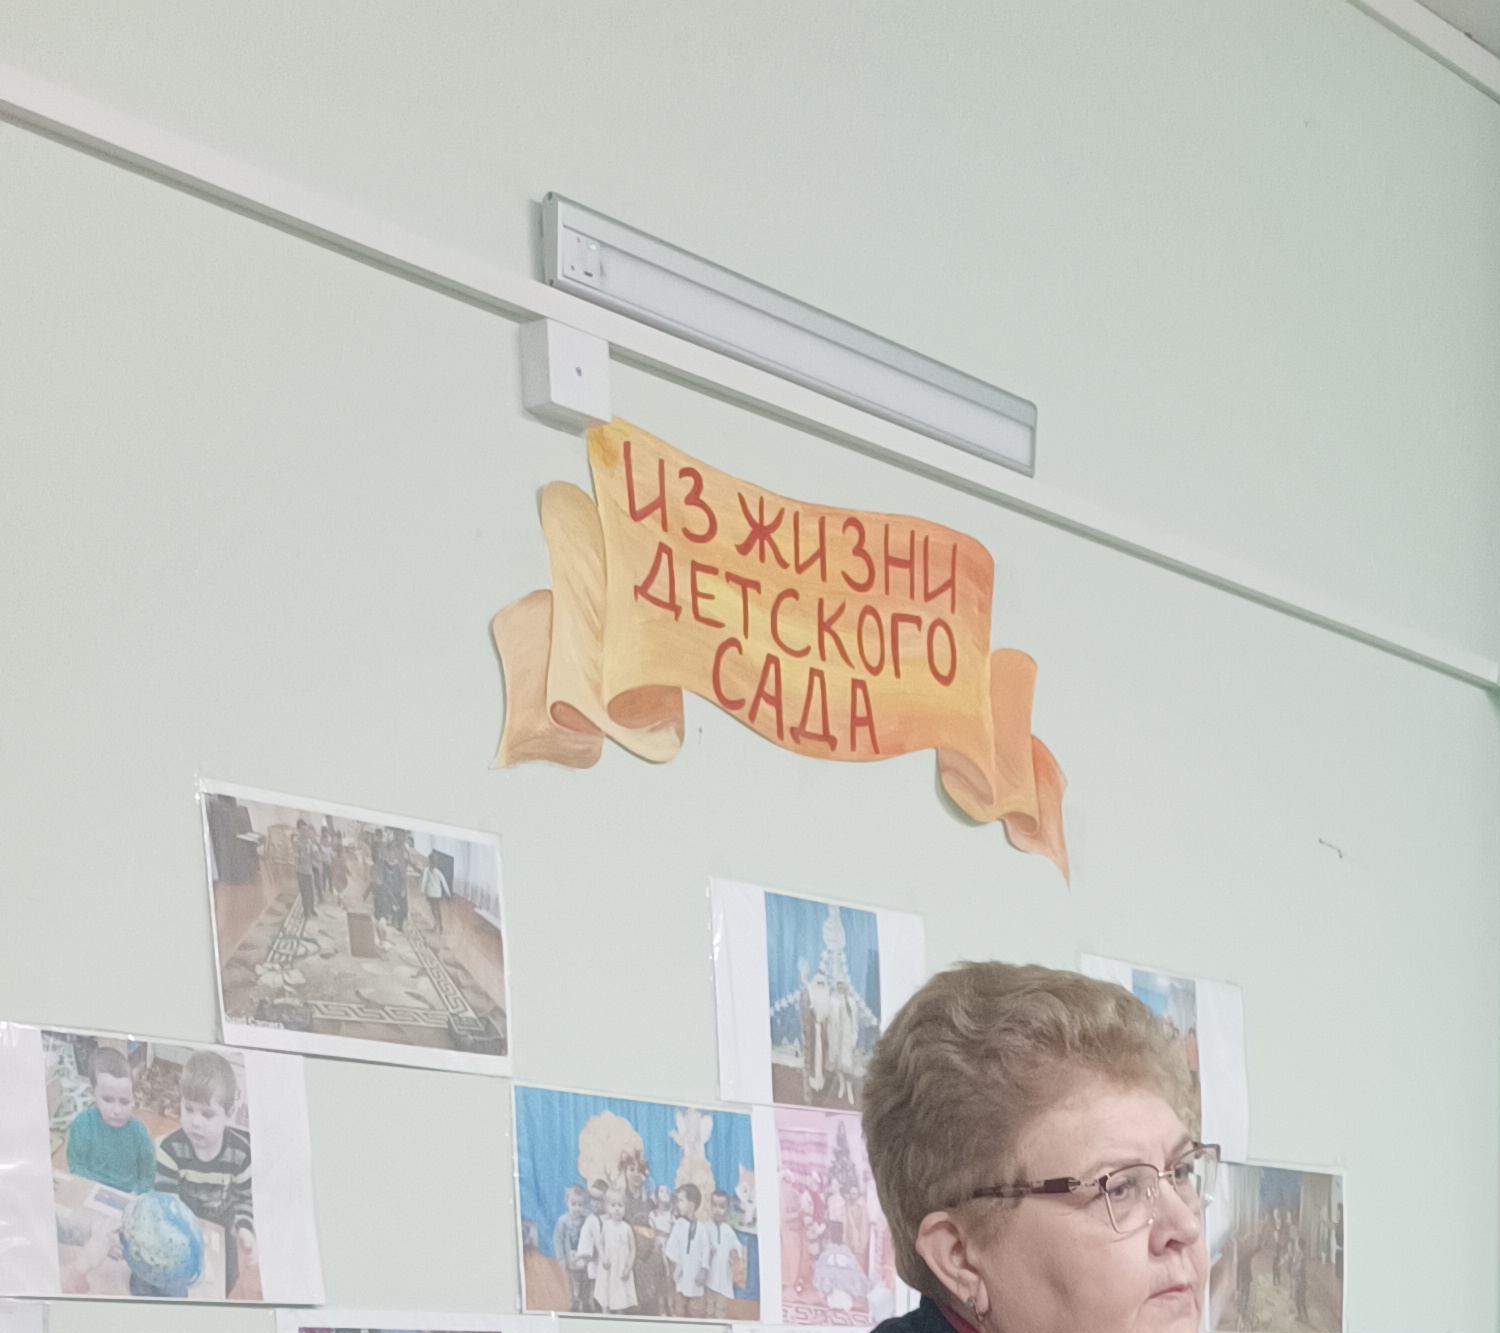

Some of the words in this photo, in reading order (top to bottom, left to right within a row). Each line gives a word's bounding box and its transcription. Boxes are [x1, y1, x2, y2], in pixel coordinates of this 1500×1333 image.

[623, 441, 718, 543] ИЗ
[733, 492, 958, 614] ЖИЗНИ
[633, 541, 957, 686] ДЕТСКОГО
[711, 637, 880, 755] САДА
